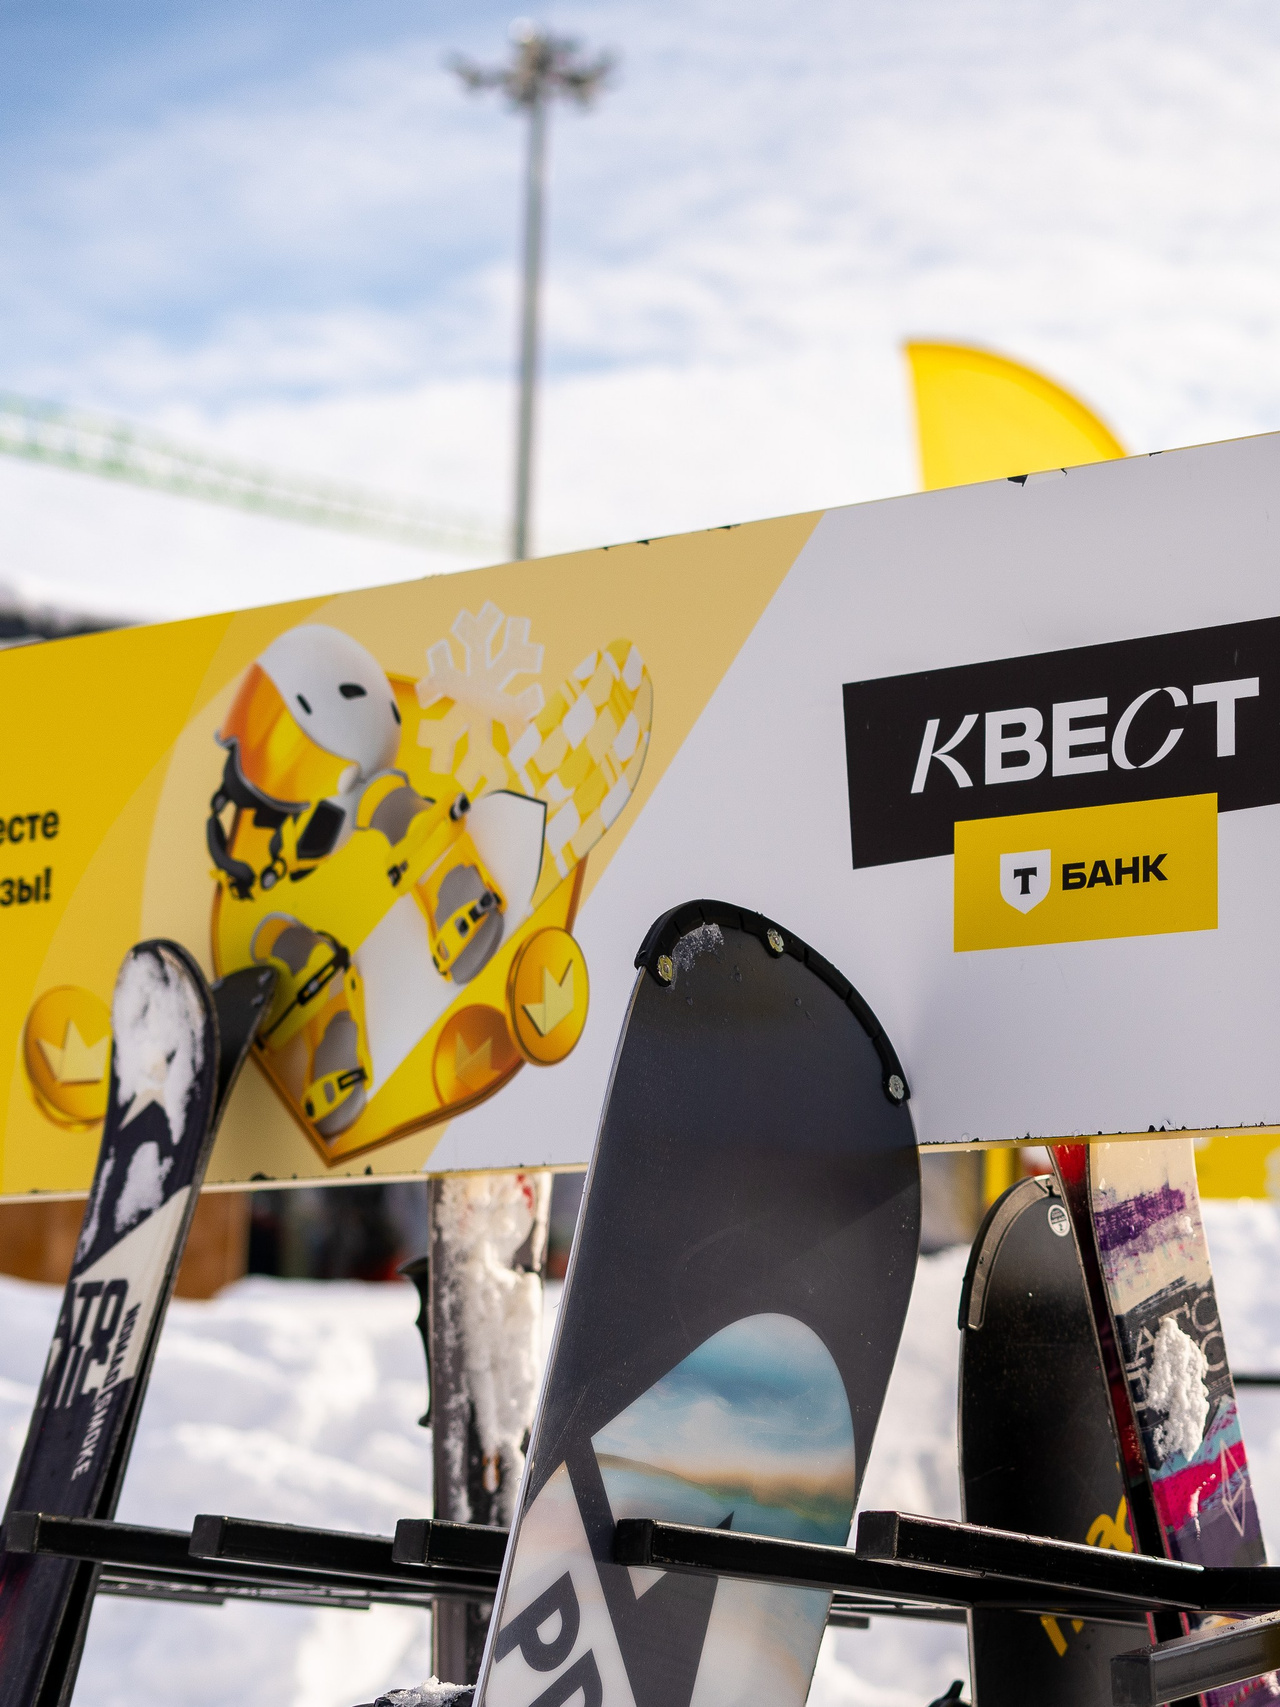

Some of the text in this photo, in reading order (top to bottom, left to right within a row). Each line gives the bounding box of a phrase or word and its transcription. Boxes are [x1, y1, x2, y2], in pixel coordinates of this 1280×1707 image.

[911, 677, 1260, 794] КВЕСТ
[0, 811, 59, 843] сте
[1062, 853, 1168, 890] БАНК
